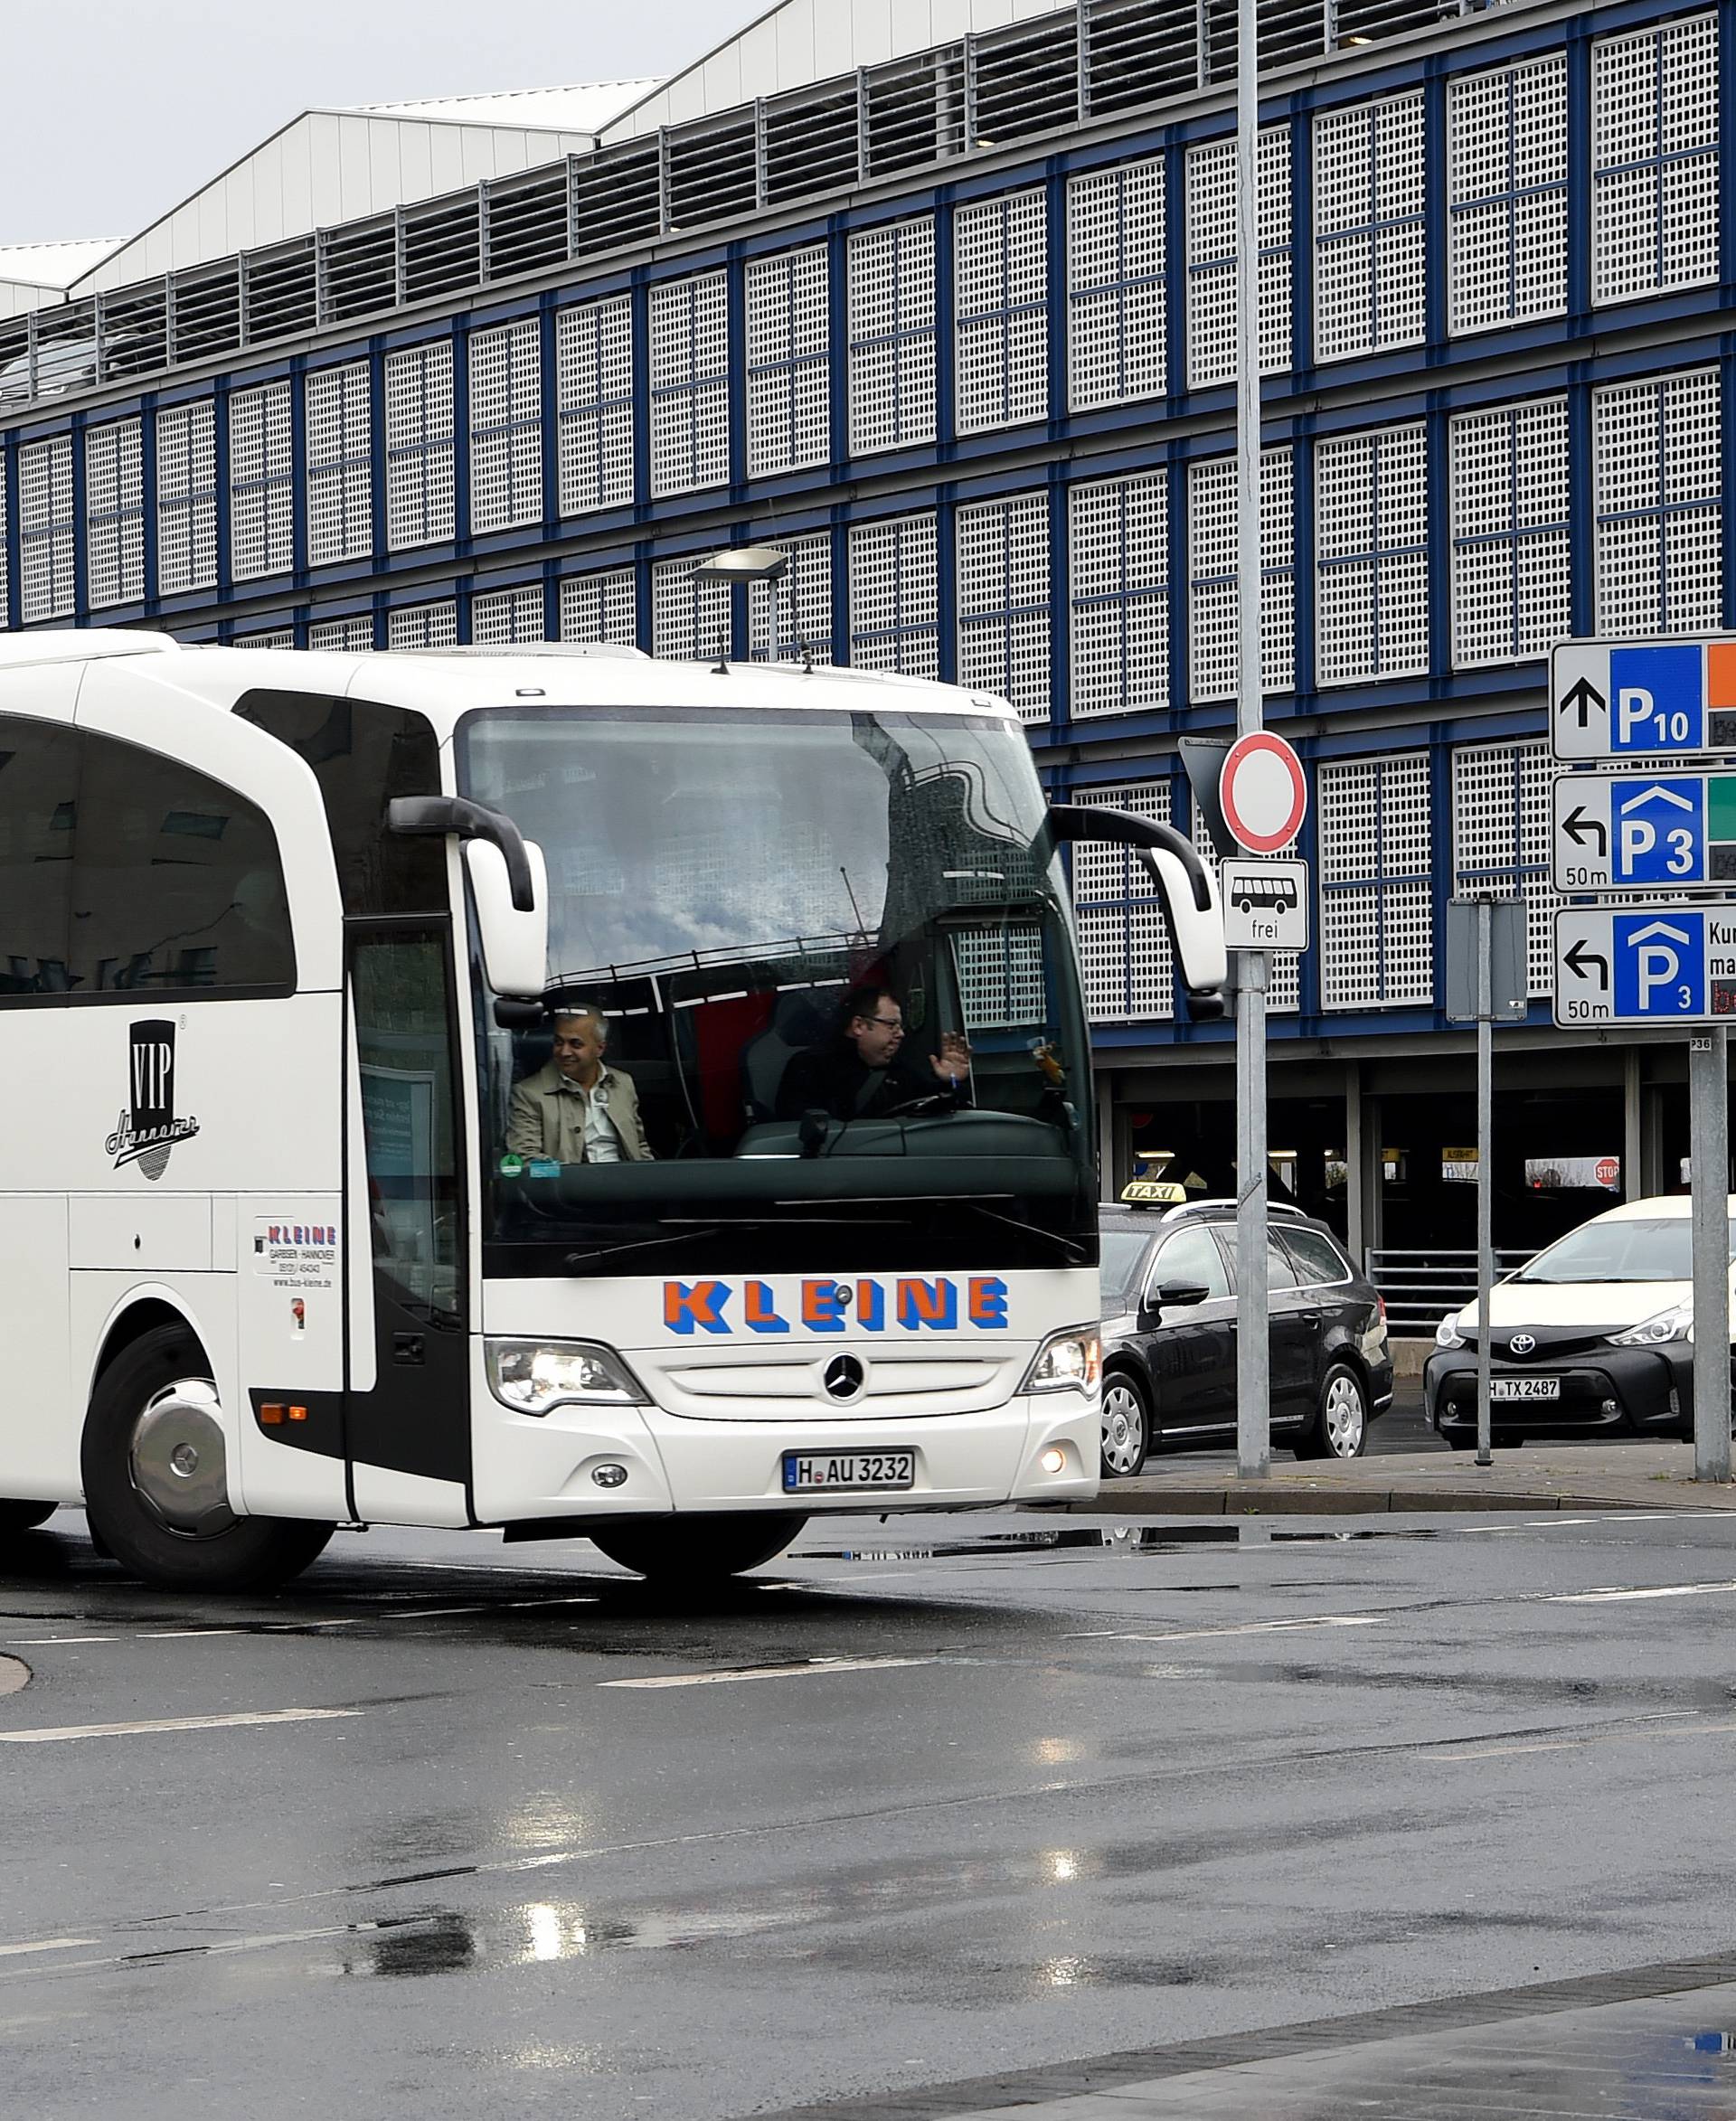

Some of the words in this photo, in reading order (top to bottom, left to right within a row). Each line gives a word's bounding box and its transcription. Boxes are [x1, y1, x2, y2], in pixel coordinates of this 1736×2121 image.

[1251, 919, 1278, 939] frei
[132, 1043, 172, 1109] VIP
[1130, 1185, 1173, 1199] TAXI
[269, 1226, 335, 1245] KLEINE
[663, 1276, 1009, 1334] KLEINE
[1505, 1381, 1522, 1397] TX
[1524, 1381, 1557, 1396] 2487
[798, 1460, 813, 1484] H
[826, 1459, 854, 1483] AU
[858, 1456, 910, 1482] 3232
